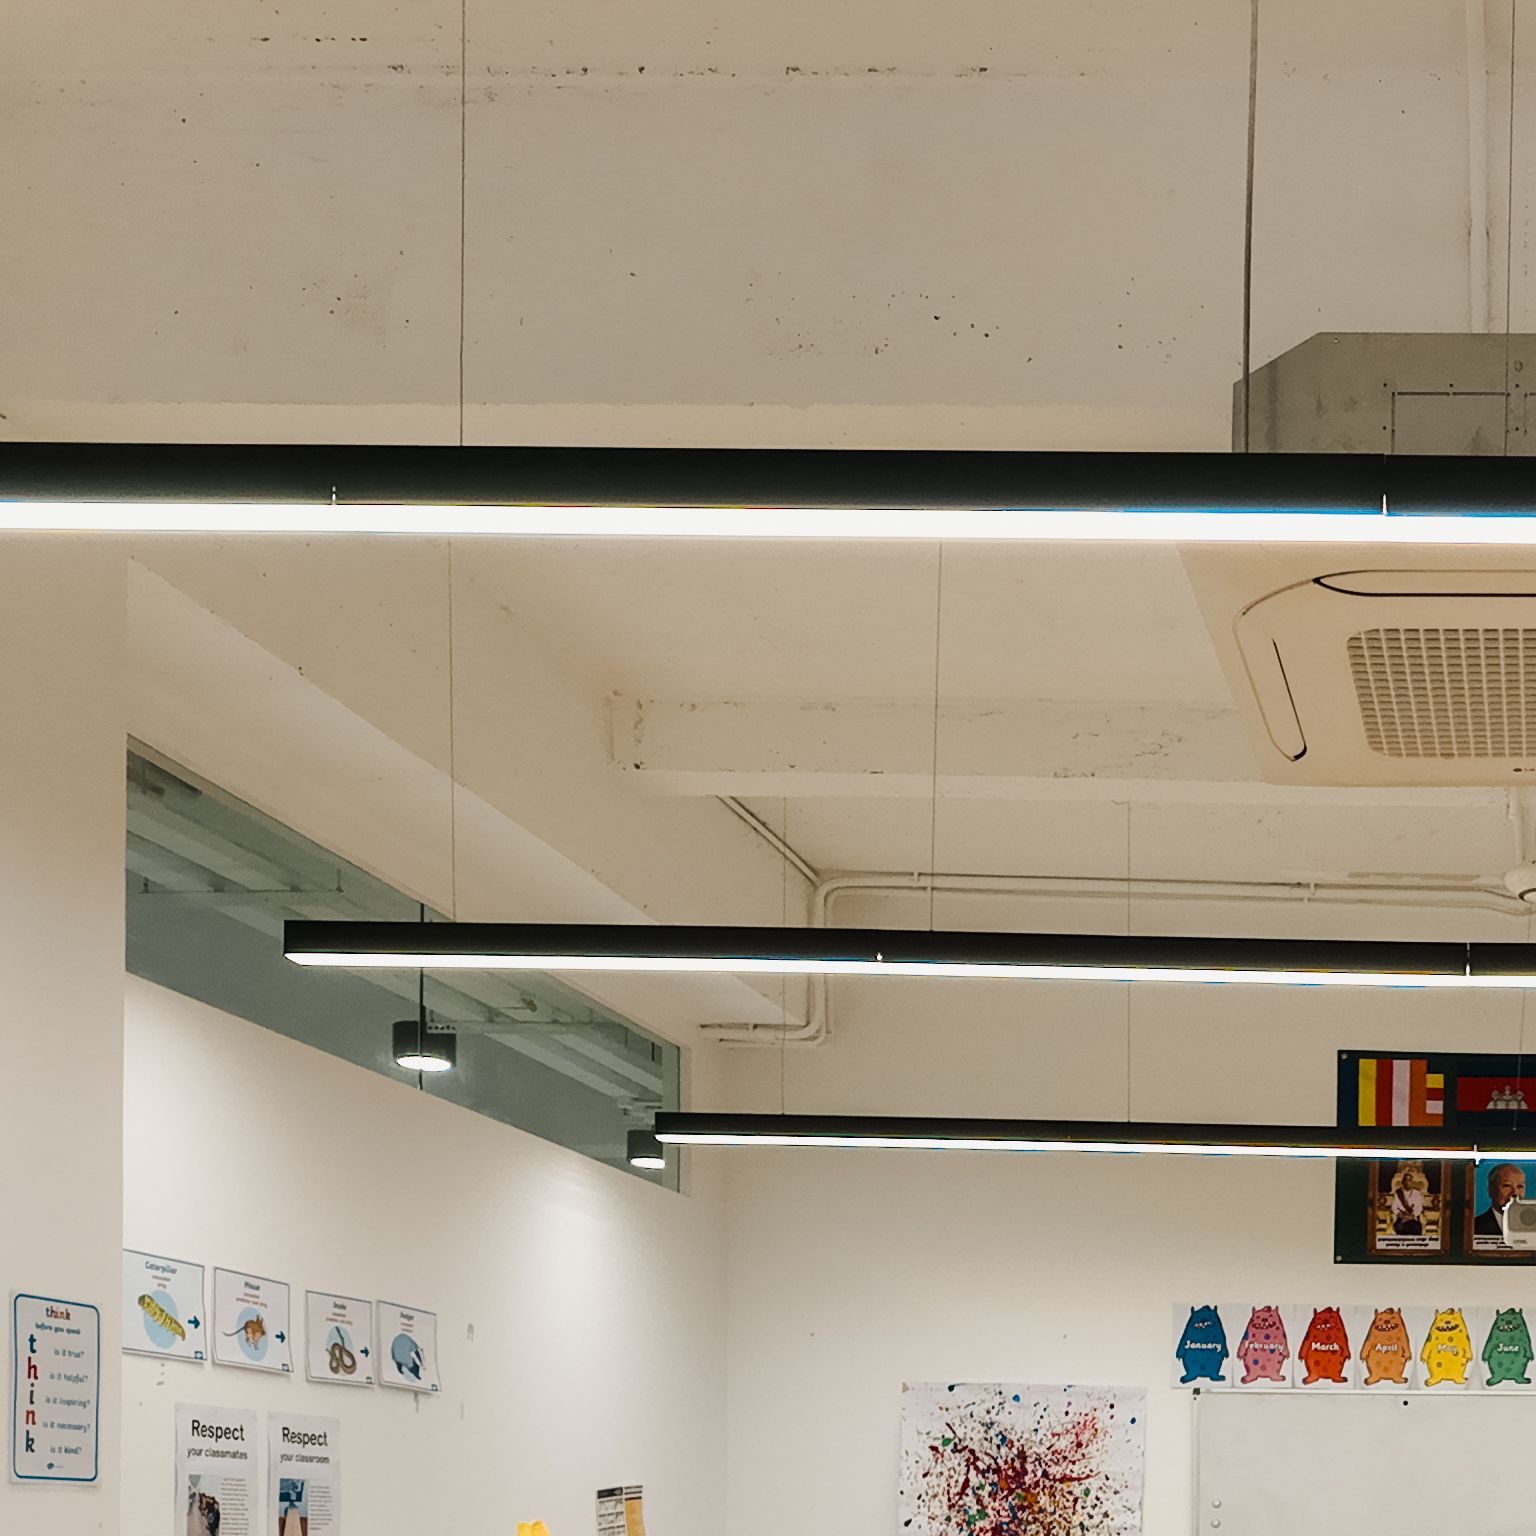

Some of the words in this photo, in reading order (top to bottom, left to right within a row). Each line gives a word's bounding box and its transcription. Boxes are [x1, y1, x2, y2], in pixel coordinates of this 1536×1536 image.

[145, 1261, 177, 1275] Caterpillar
[46, 1305, 71, 1320] think
[1184, 1340, 1221, 1352] January
[1245, 1341, 1284, 1352] February
[1311, 1342, 1340, 1351] March
[1375, 1343, 1398, 1354] April
[1437, 1343, 1457, 1354] May
[1497, 1343, 1519, 1352] June
[191, 1419, 245, 1442] Respect
[282, 1426, 328, 1448] Respect
[187, 1448, 203, 1458] your
[204, 1448, 248, 1460] classmates
[280, 1453, 293, 1463] your
[295, 1452, 330, 1464] classroom
